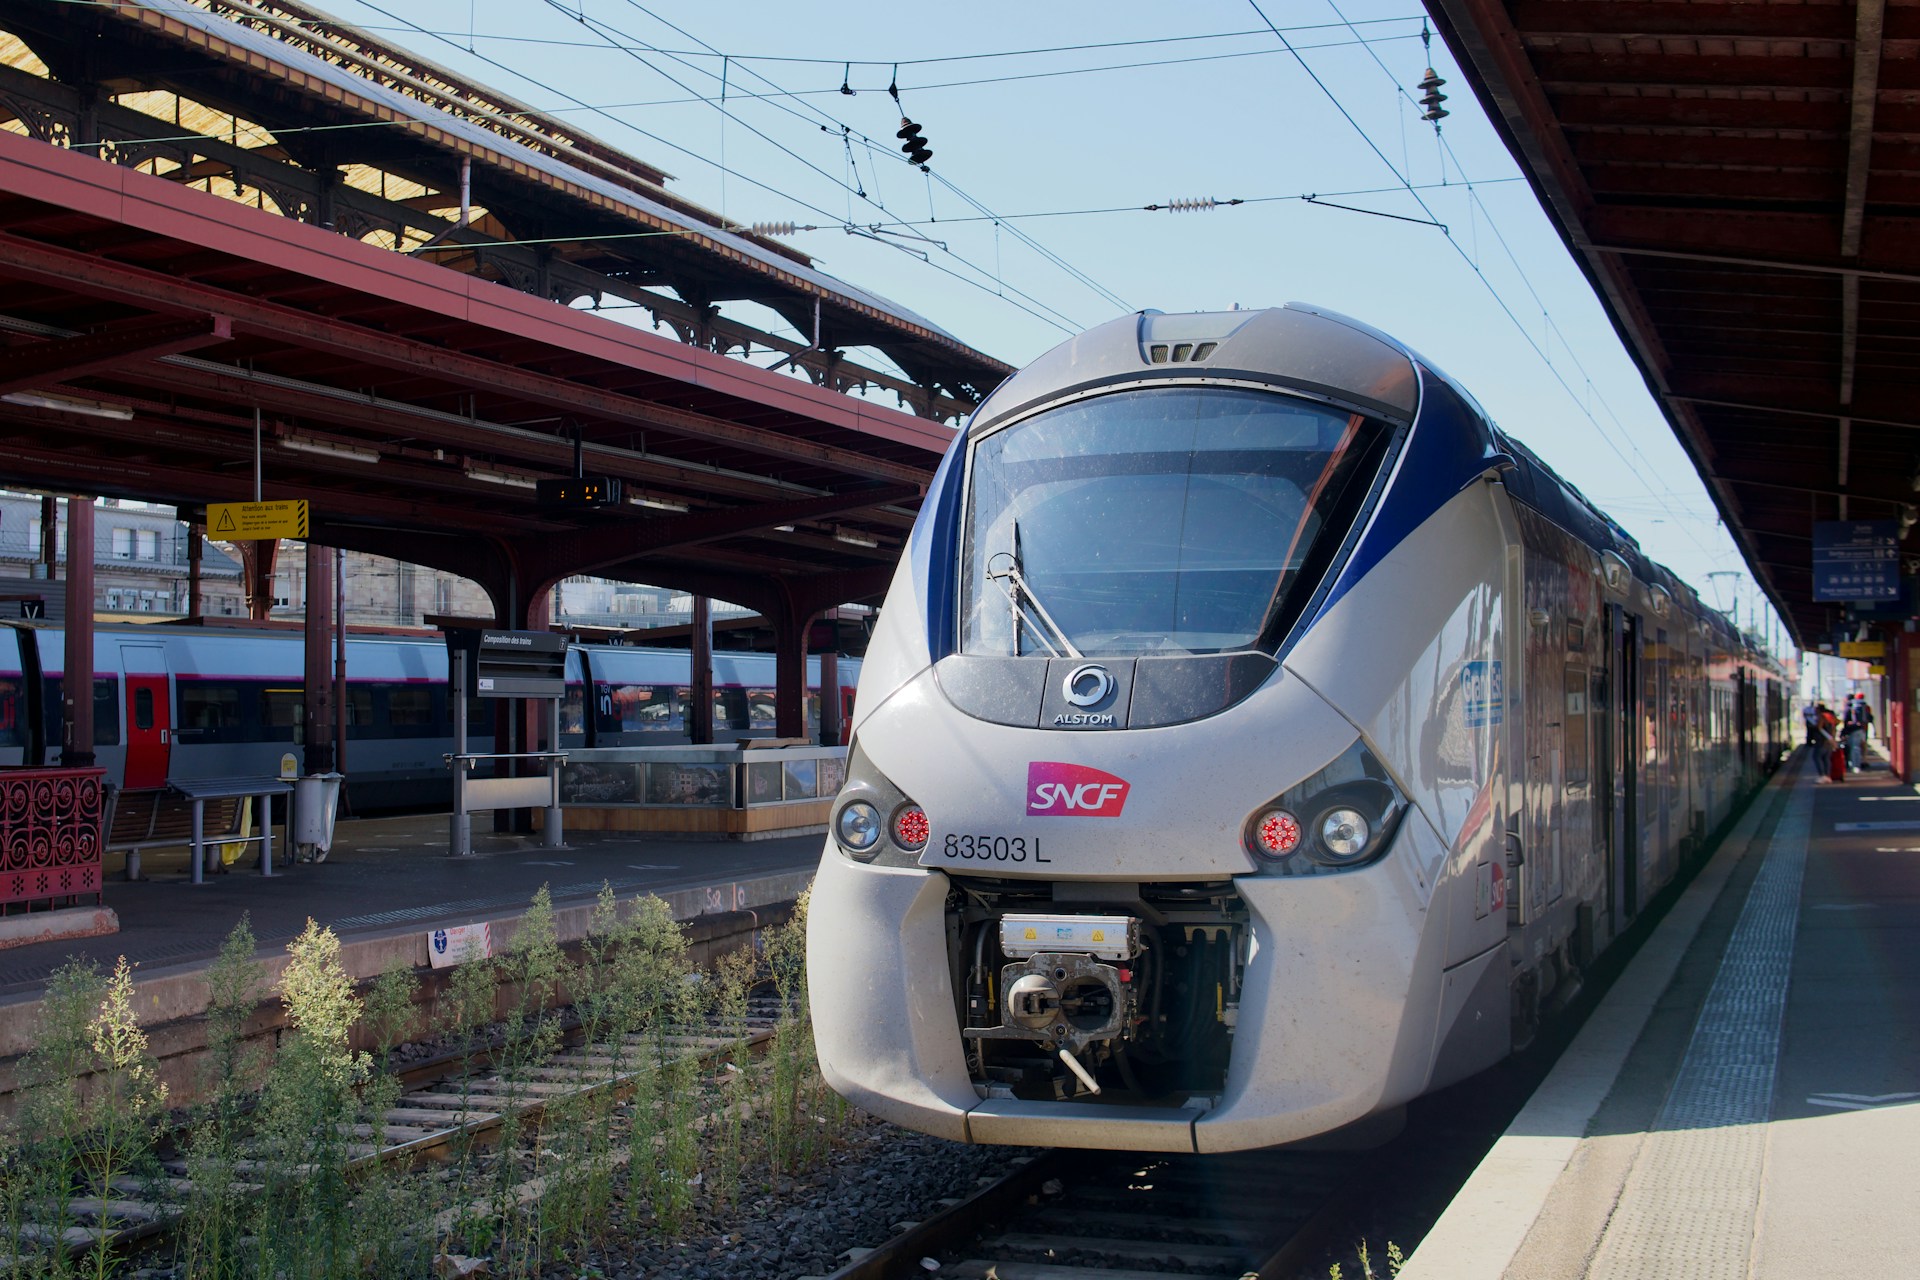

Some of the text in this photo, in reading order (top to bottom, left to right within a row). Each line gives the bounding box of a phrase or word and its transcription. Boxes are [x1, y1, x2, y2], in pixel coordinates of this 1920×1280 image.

[242, 504, 263, 512] Attention
[484, 634, 511, 645] Composition
[511, 636, 520, 645] des
[601, 684, 611, 694] TGV
[1054, 713, 1113, 724] ALSTOM
[1031, 783, 1123, 810] SNCF
[944, 834, 1051, 862] 83503 L
